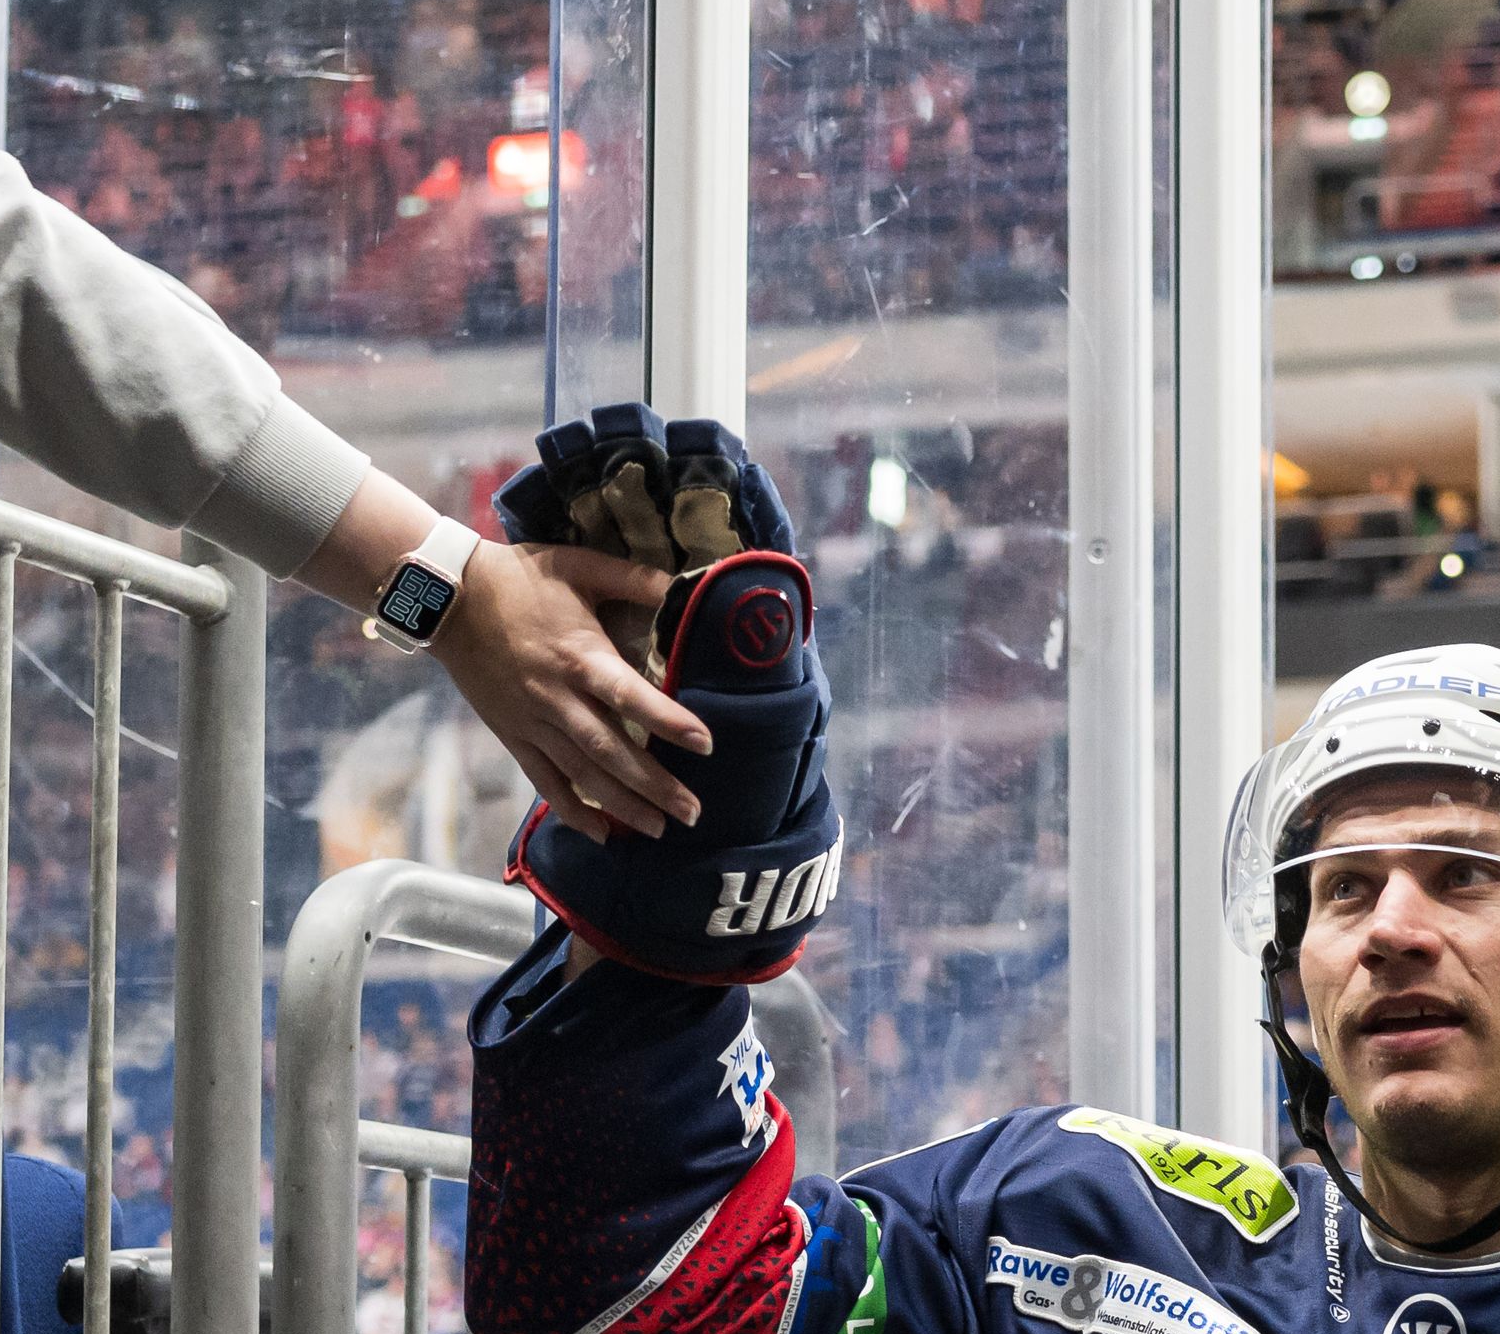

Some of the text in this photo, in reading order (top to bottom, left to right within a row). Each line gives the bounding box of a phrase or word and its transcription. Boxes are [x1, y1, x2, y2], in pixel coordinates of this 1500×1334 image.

[1150, 1151, 1182, 1184] 1921
[660, 1216, 708, 1274] MARZAHN
[987, 1245, 1070, 1287] Rawe
[1061, 1263, 1106, 1319] &
